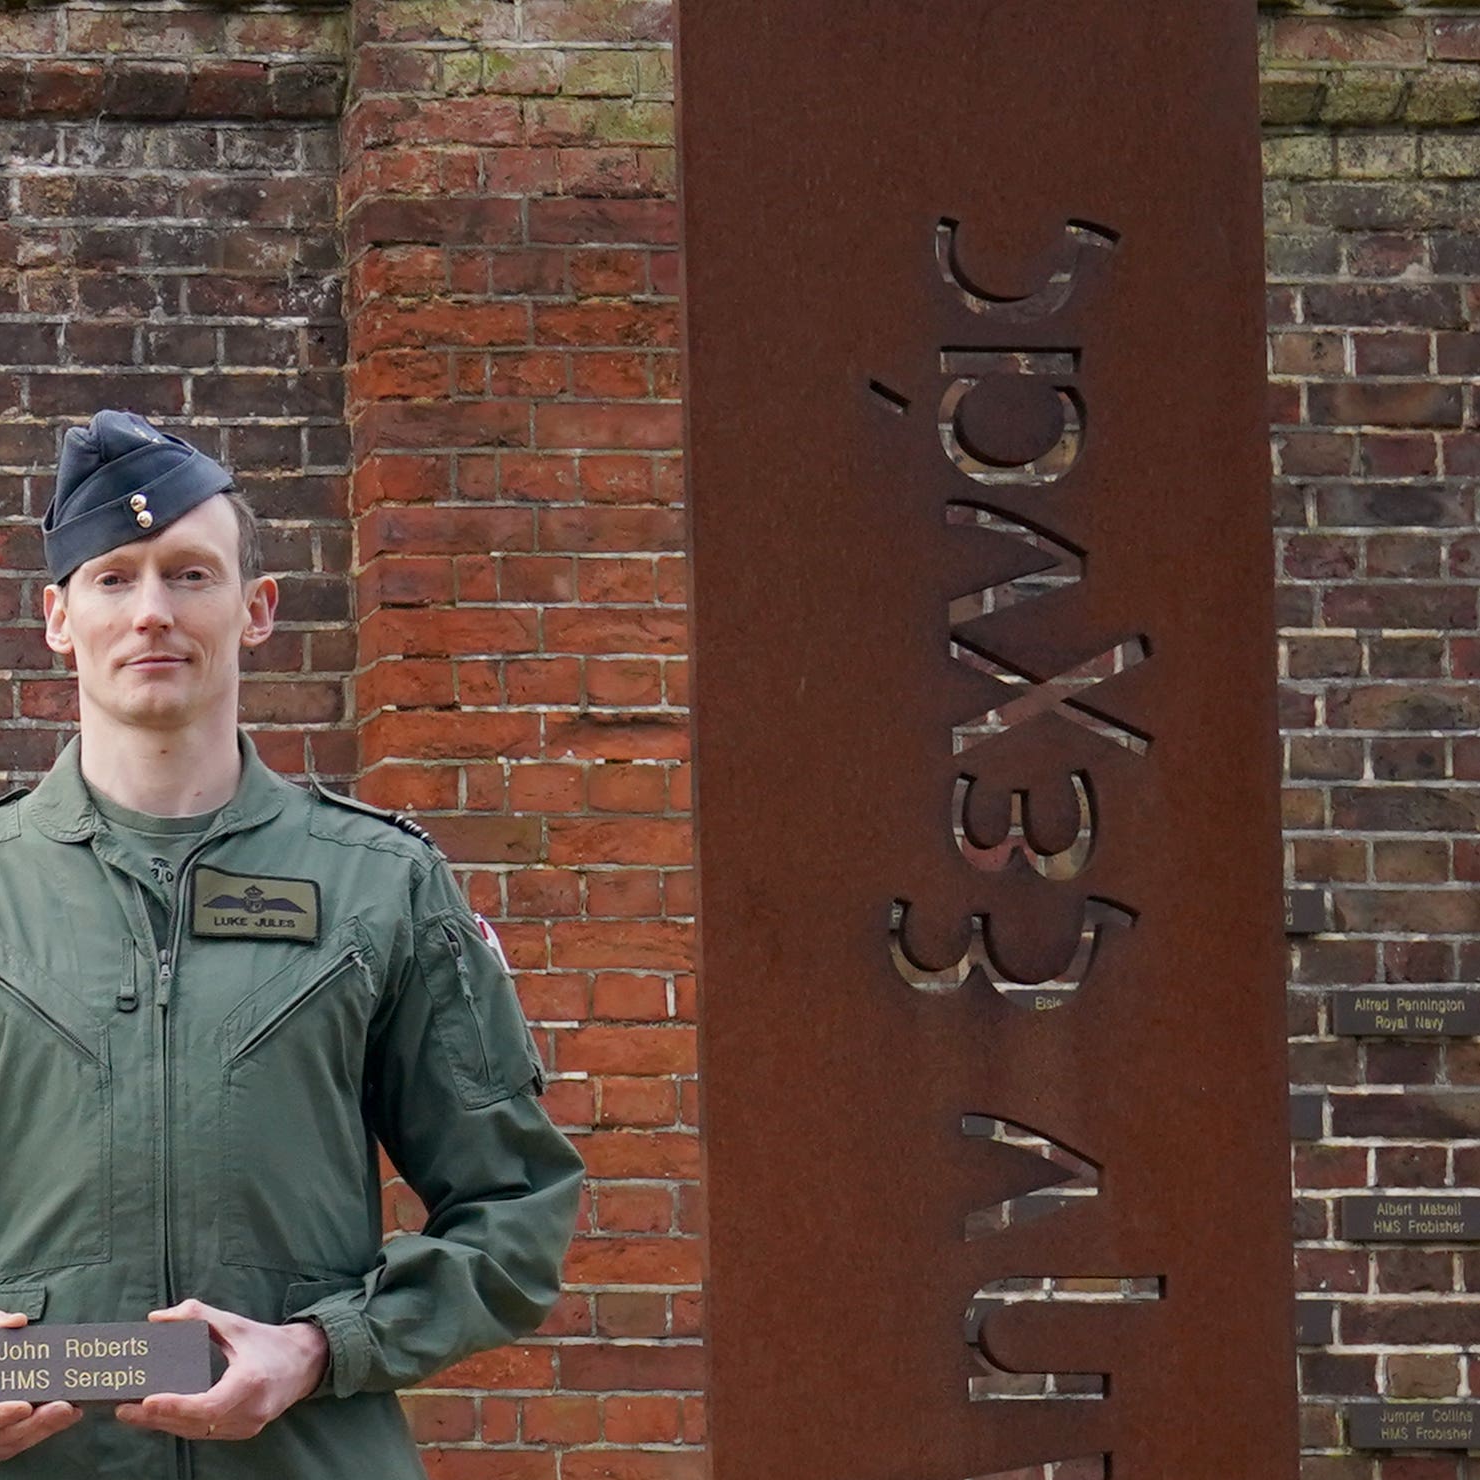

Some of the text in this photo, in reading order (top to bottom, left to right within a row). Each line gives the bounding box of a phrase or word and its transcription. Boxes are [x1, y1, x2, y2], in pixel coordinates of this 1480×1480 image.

[214, 917, 296, 928] LUKE JULES
[1354, 998, 1466, 1014] Alfred Pennington
[1375, 1016, 1444, 1032] Royal Navy
[1377, 1202, 1413, 1216] Albert
[1373, 1220, 1465, 1233] HMS Frobisher
[65, 1336, 149, 1358] Roberts
[0, 1366, 147, 1390] HMS Serapis
[1379, 1409, 1474, 1425] Jumper Collins
[1381, 1426, 1473, 1441] HMS Frobisher
